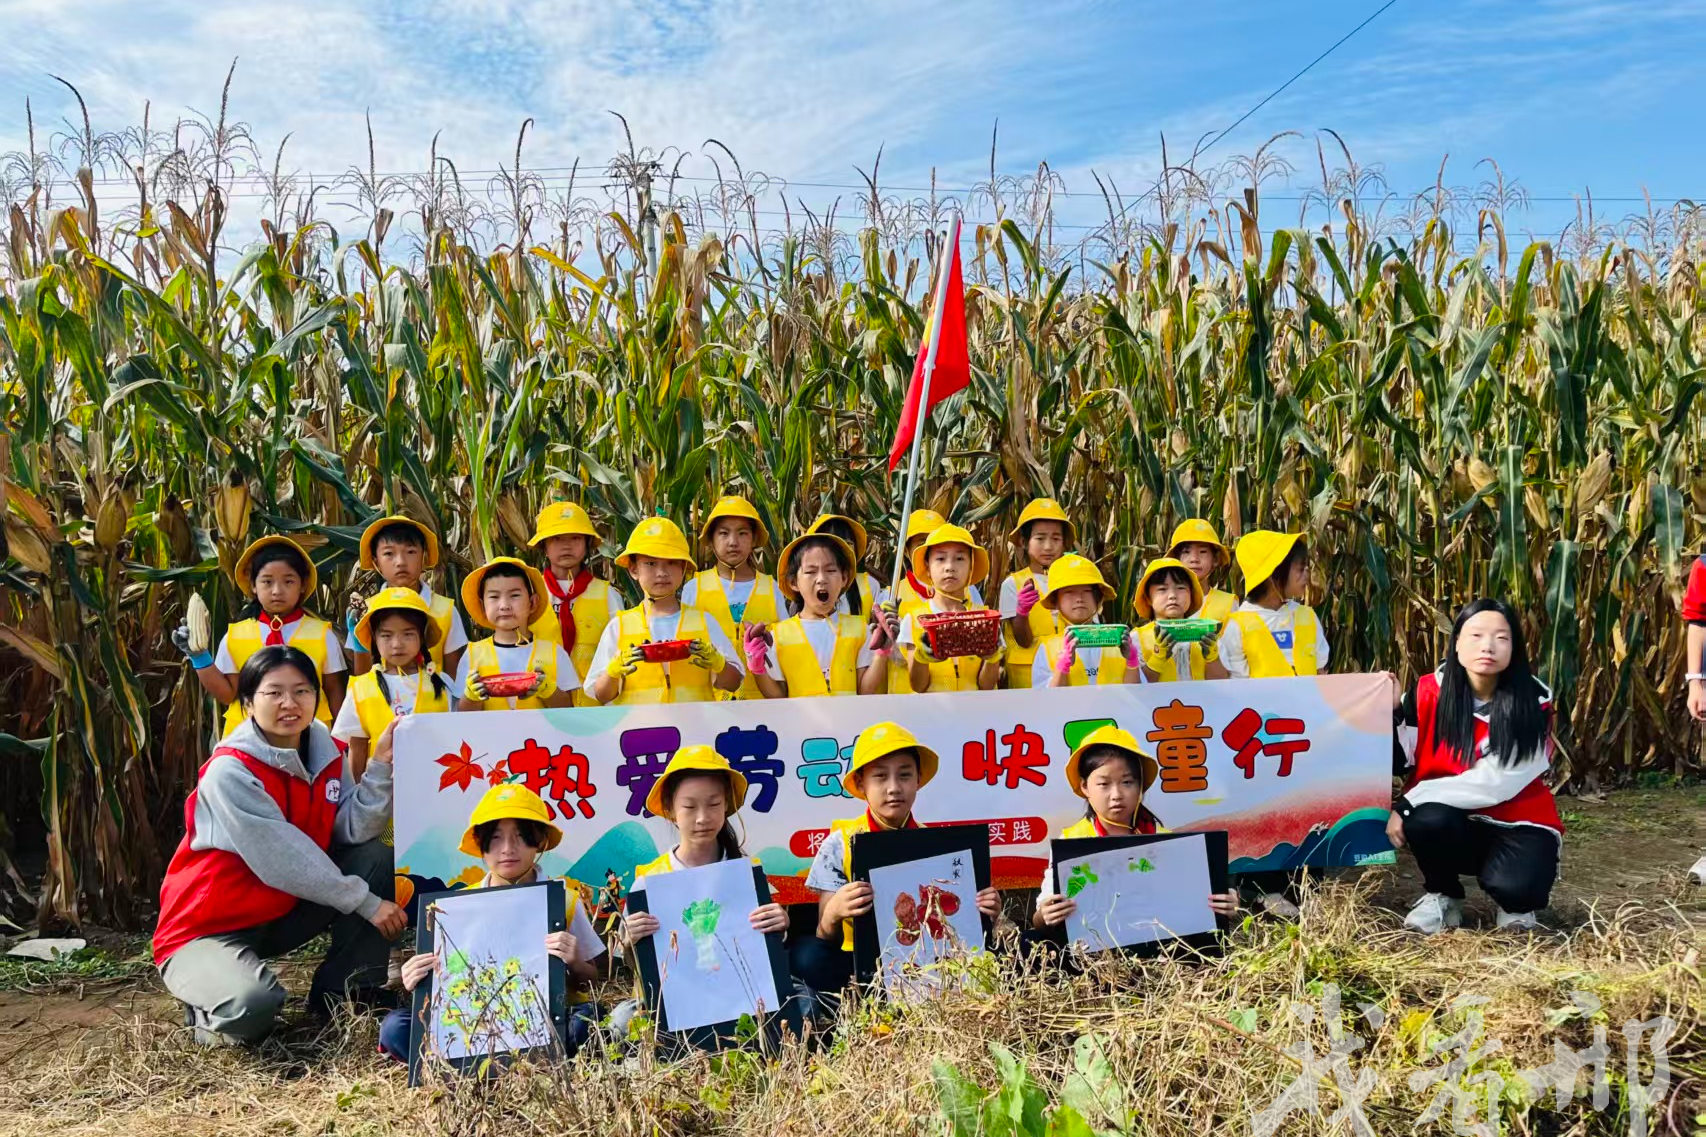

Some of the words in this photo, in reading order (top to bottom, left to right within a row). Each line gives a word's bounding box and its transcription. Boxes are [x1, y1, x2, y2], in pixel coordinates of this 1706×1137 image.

[963, 699, 1311, 794] 快童行
[988, 820, 1032, 843] 实践
